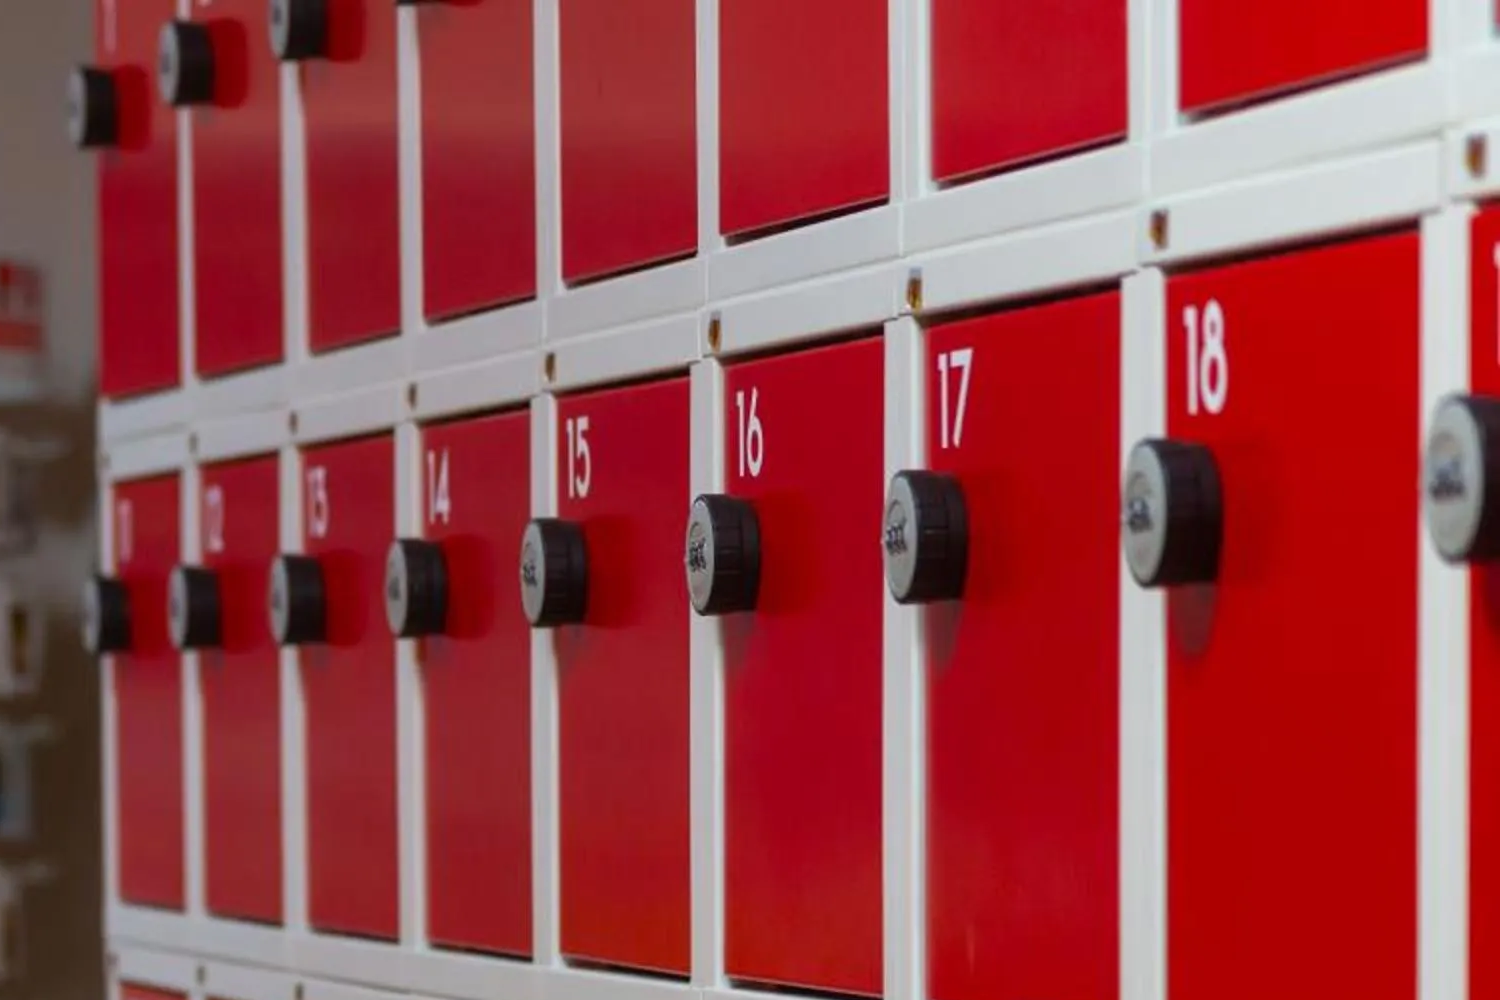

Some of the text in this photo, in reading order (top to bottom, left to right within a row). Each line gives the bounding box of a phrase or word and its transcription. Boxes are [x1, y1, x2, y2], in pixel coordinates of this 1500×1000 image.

[937, 347, 973, 449] 17
[1183, 299, 1228, 415] 18
[566, 415, 591, 499] 15
[736, 386, 764, 477] 16
[306, 466, 329, 538] 13
[426, 450, 451, 525] 14
